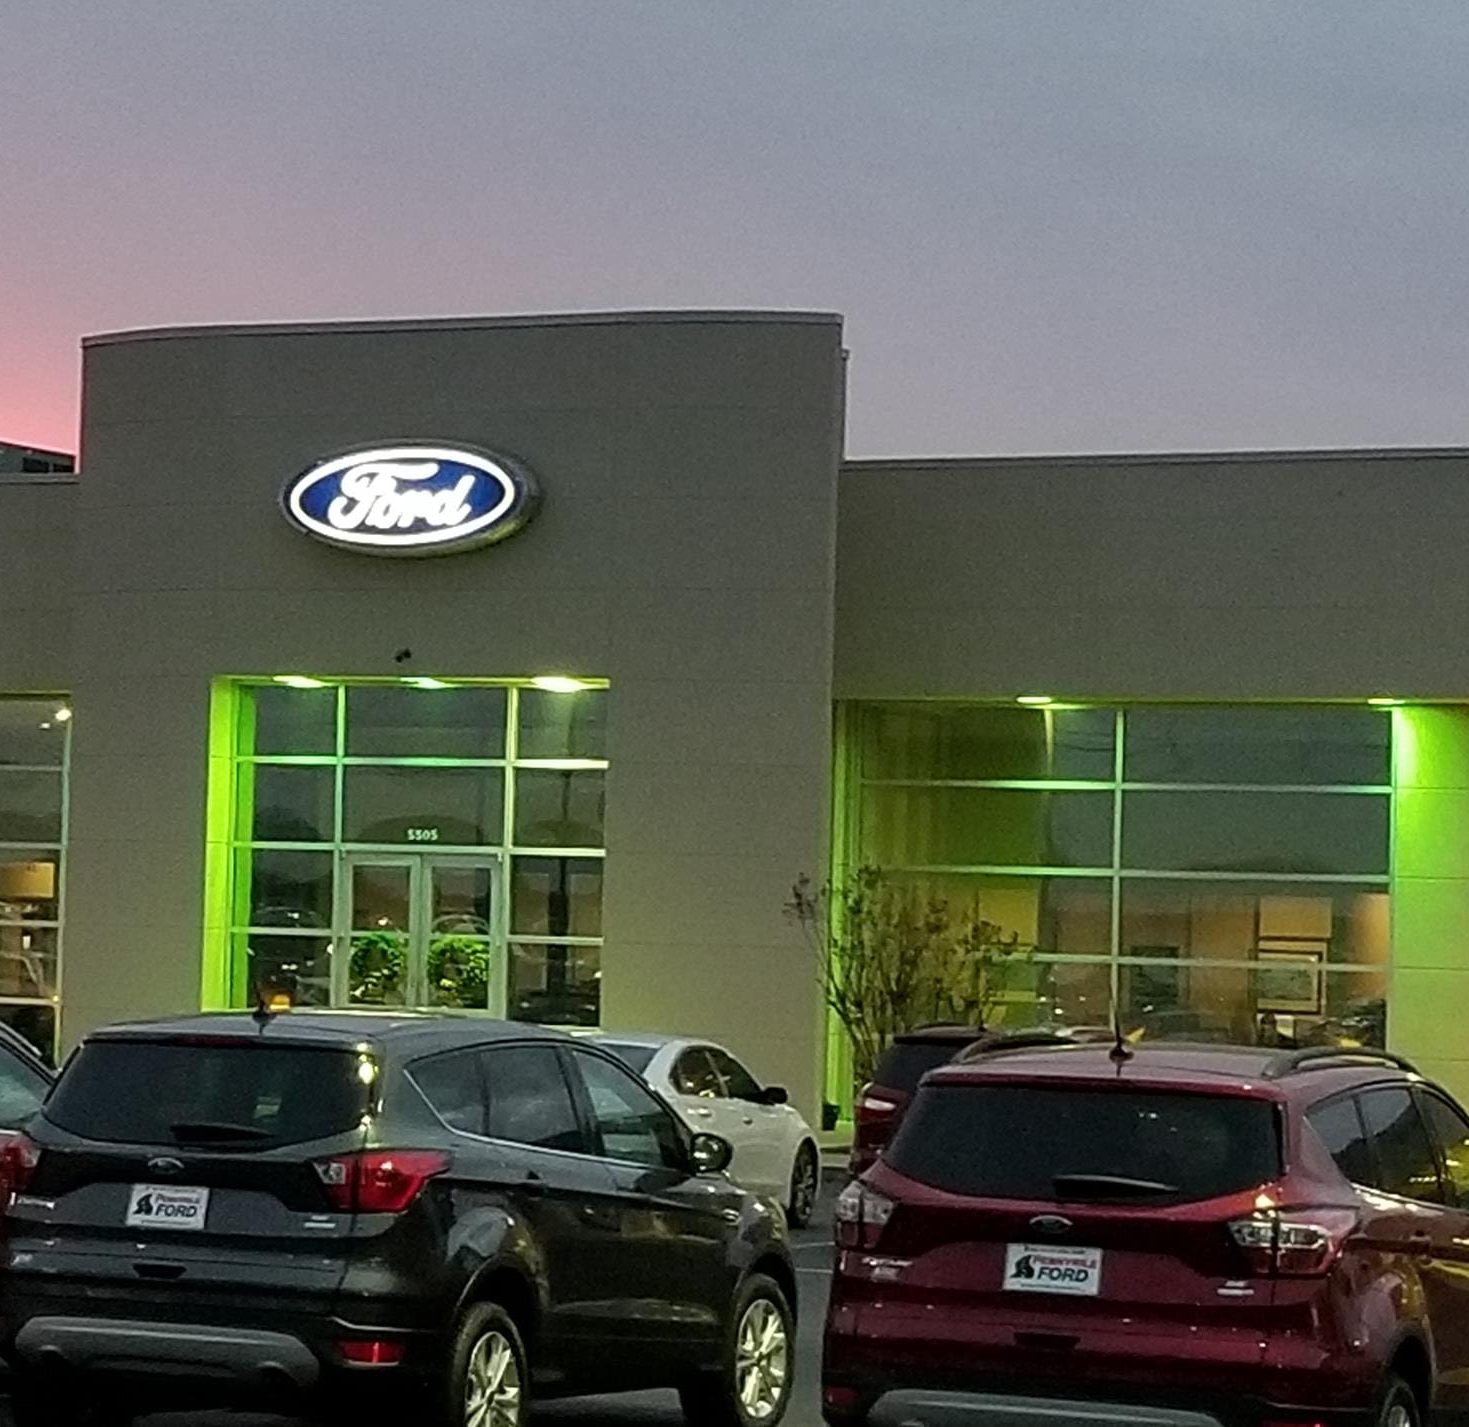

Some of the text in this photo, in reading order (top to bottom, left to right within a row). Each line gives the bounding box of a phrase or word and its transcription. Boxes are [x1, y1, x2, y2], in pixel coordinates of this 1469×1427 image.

[328, 462, 475, 529] Ford
[155, 1203, 198, 1217] FORD
[1037, 1266, 1089, 1282] FORD
